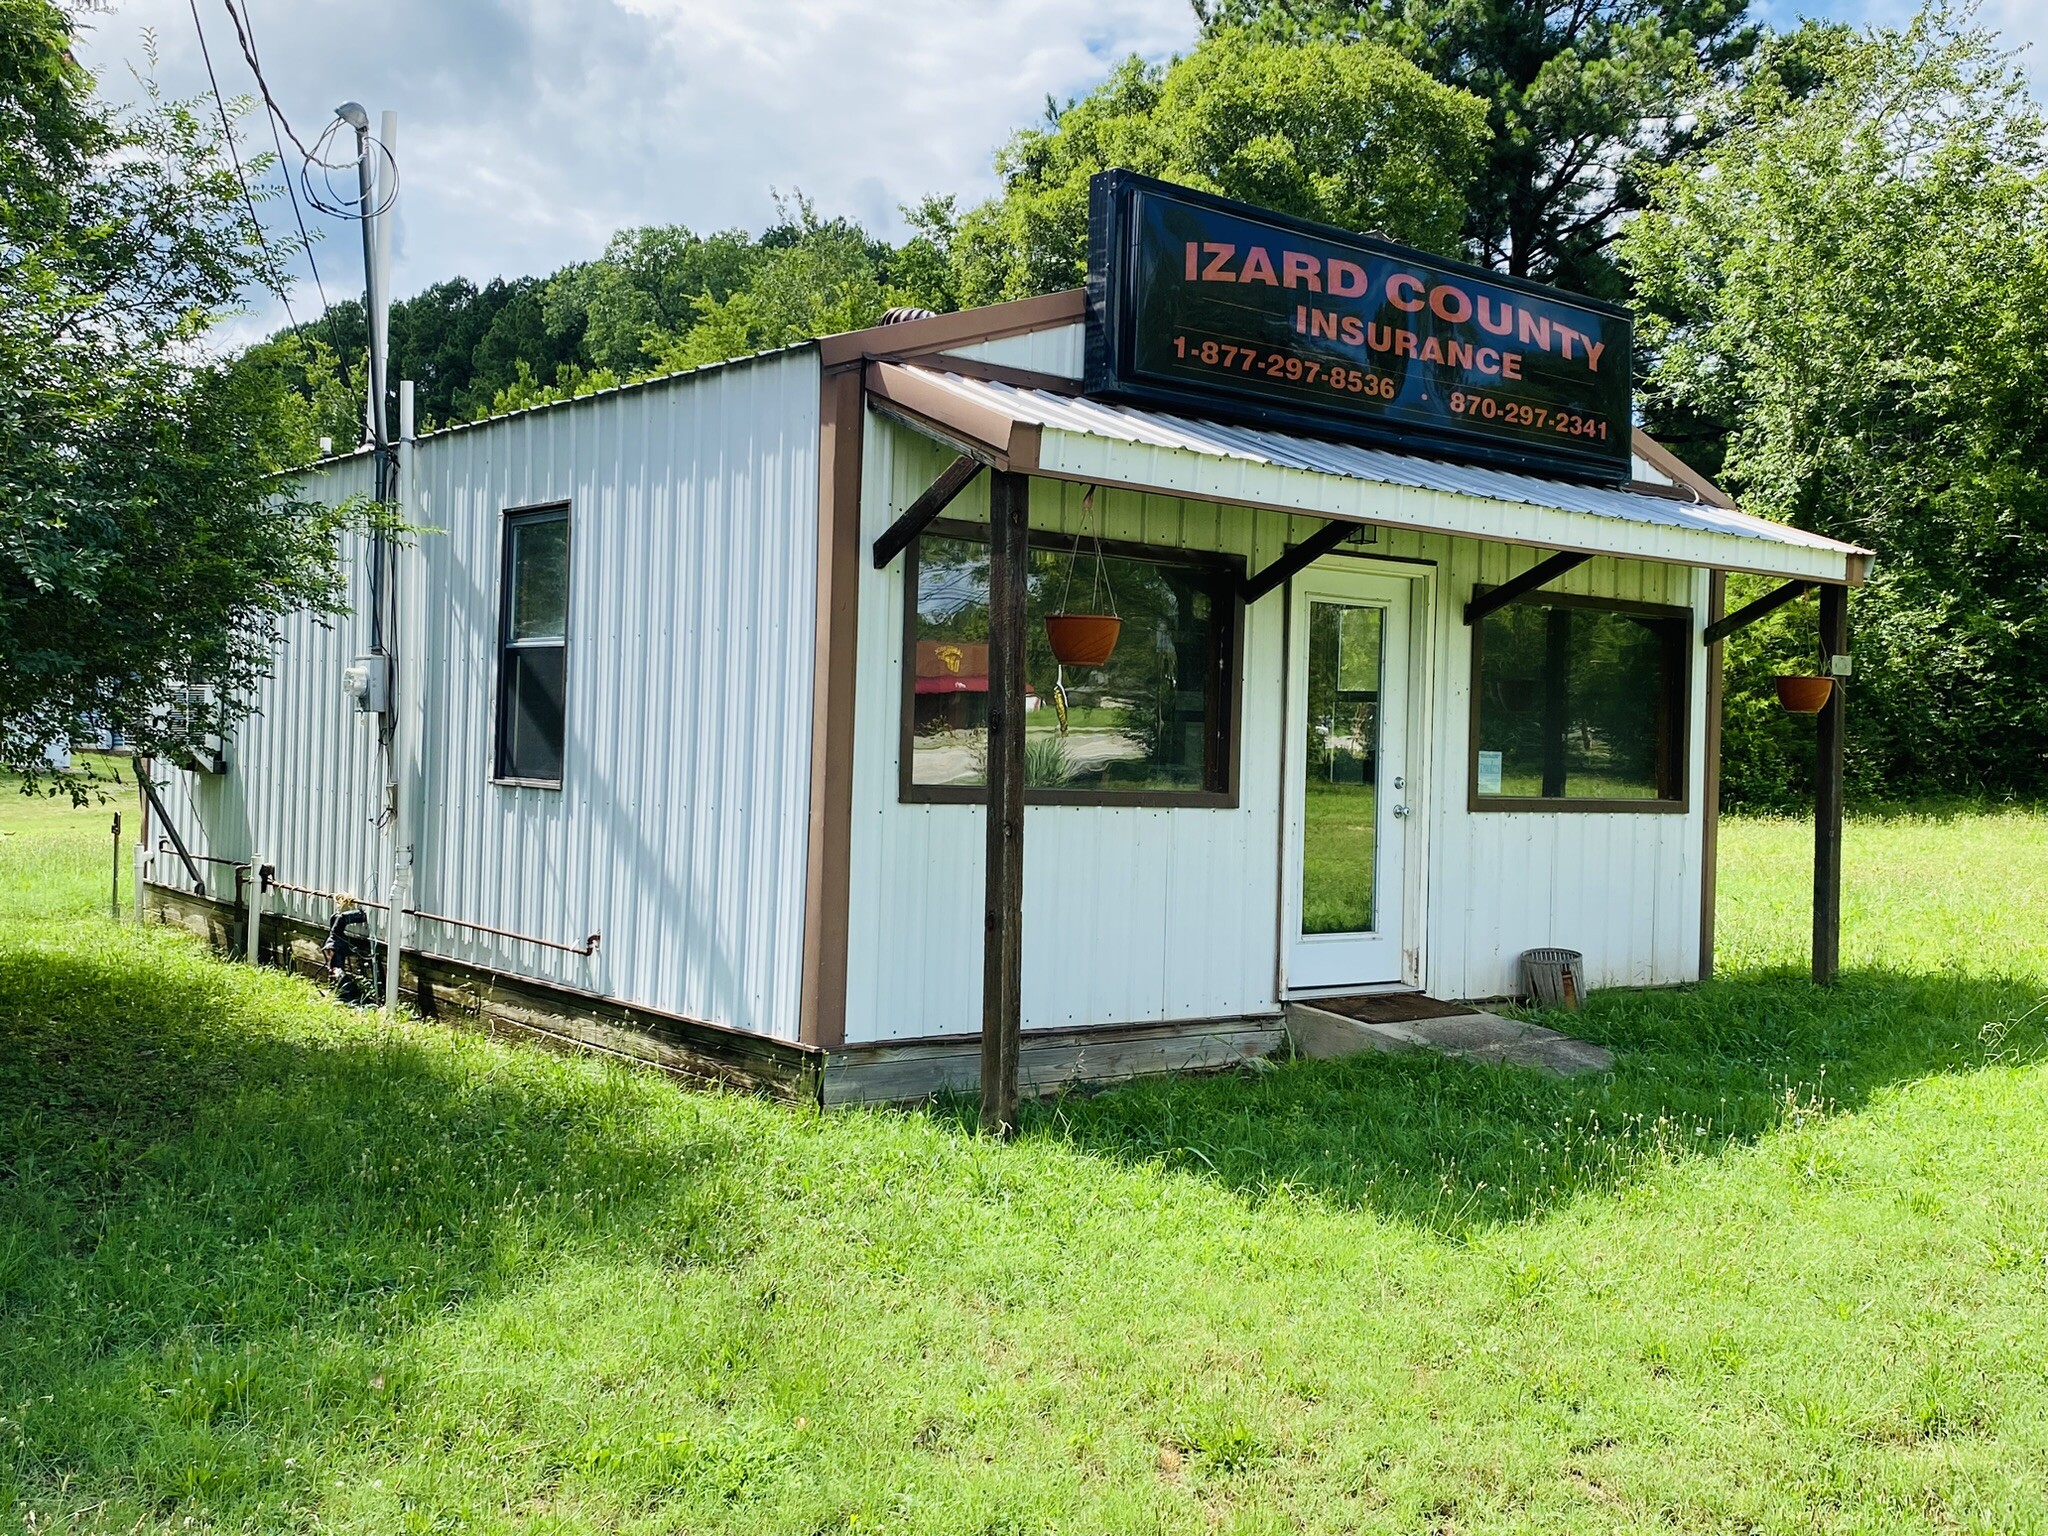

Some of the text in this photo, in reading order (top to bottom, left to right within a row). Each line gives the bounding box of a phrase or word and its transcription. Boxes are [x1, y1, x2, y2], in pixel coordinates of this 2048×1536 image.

[1185, 242, 1605, 373] IZARD COUNTY
[1296, 305, 1522, 381] INSURANCE
[1173, 335, 1607, 440] 1-877-297-8536 870-297-2341
